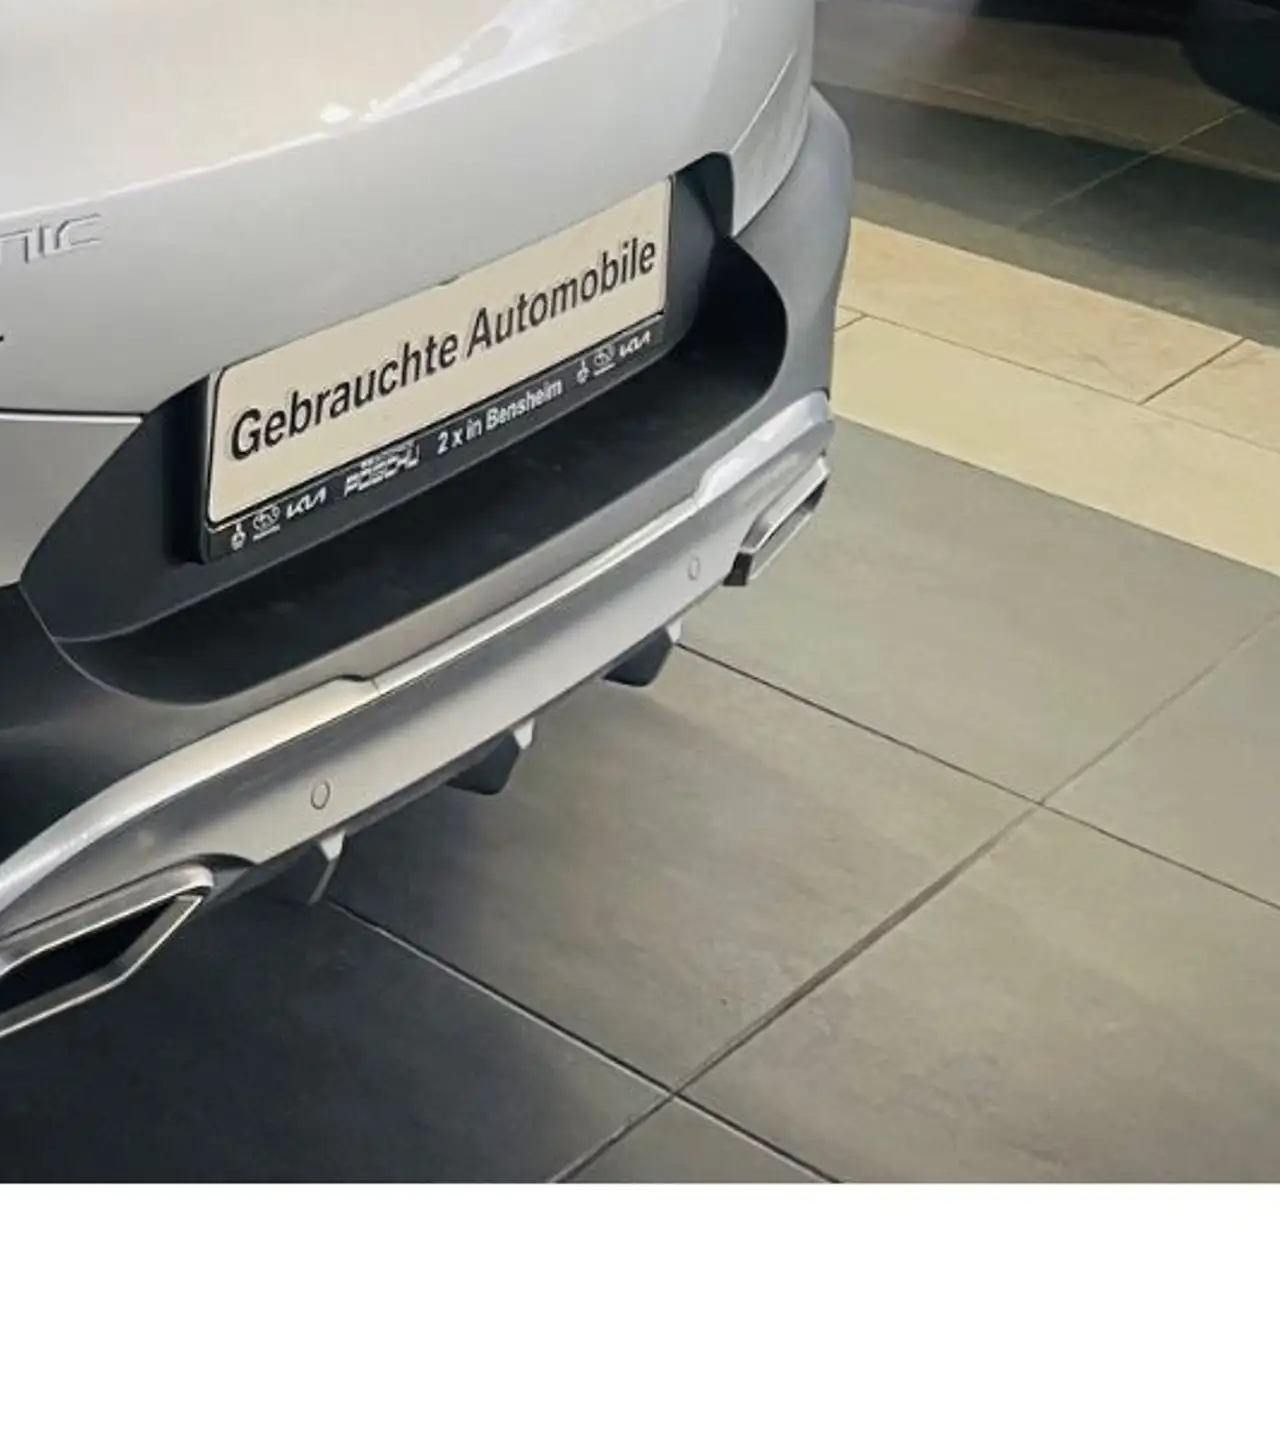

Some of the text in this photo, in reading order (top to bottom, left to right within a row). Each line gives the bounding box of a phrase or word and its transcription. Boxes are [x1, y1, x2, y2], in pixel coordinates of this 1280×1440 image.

[229, 237, 657, 460] Gebrauchte Automobile
[466, 415, 483, 441] in
[485, 378, 563, 432] Bensheim
